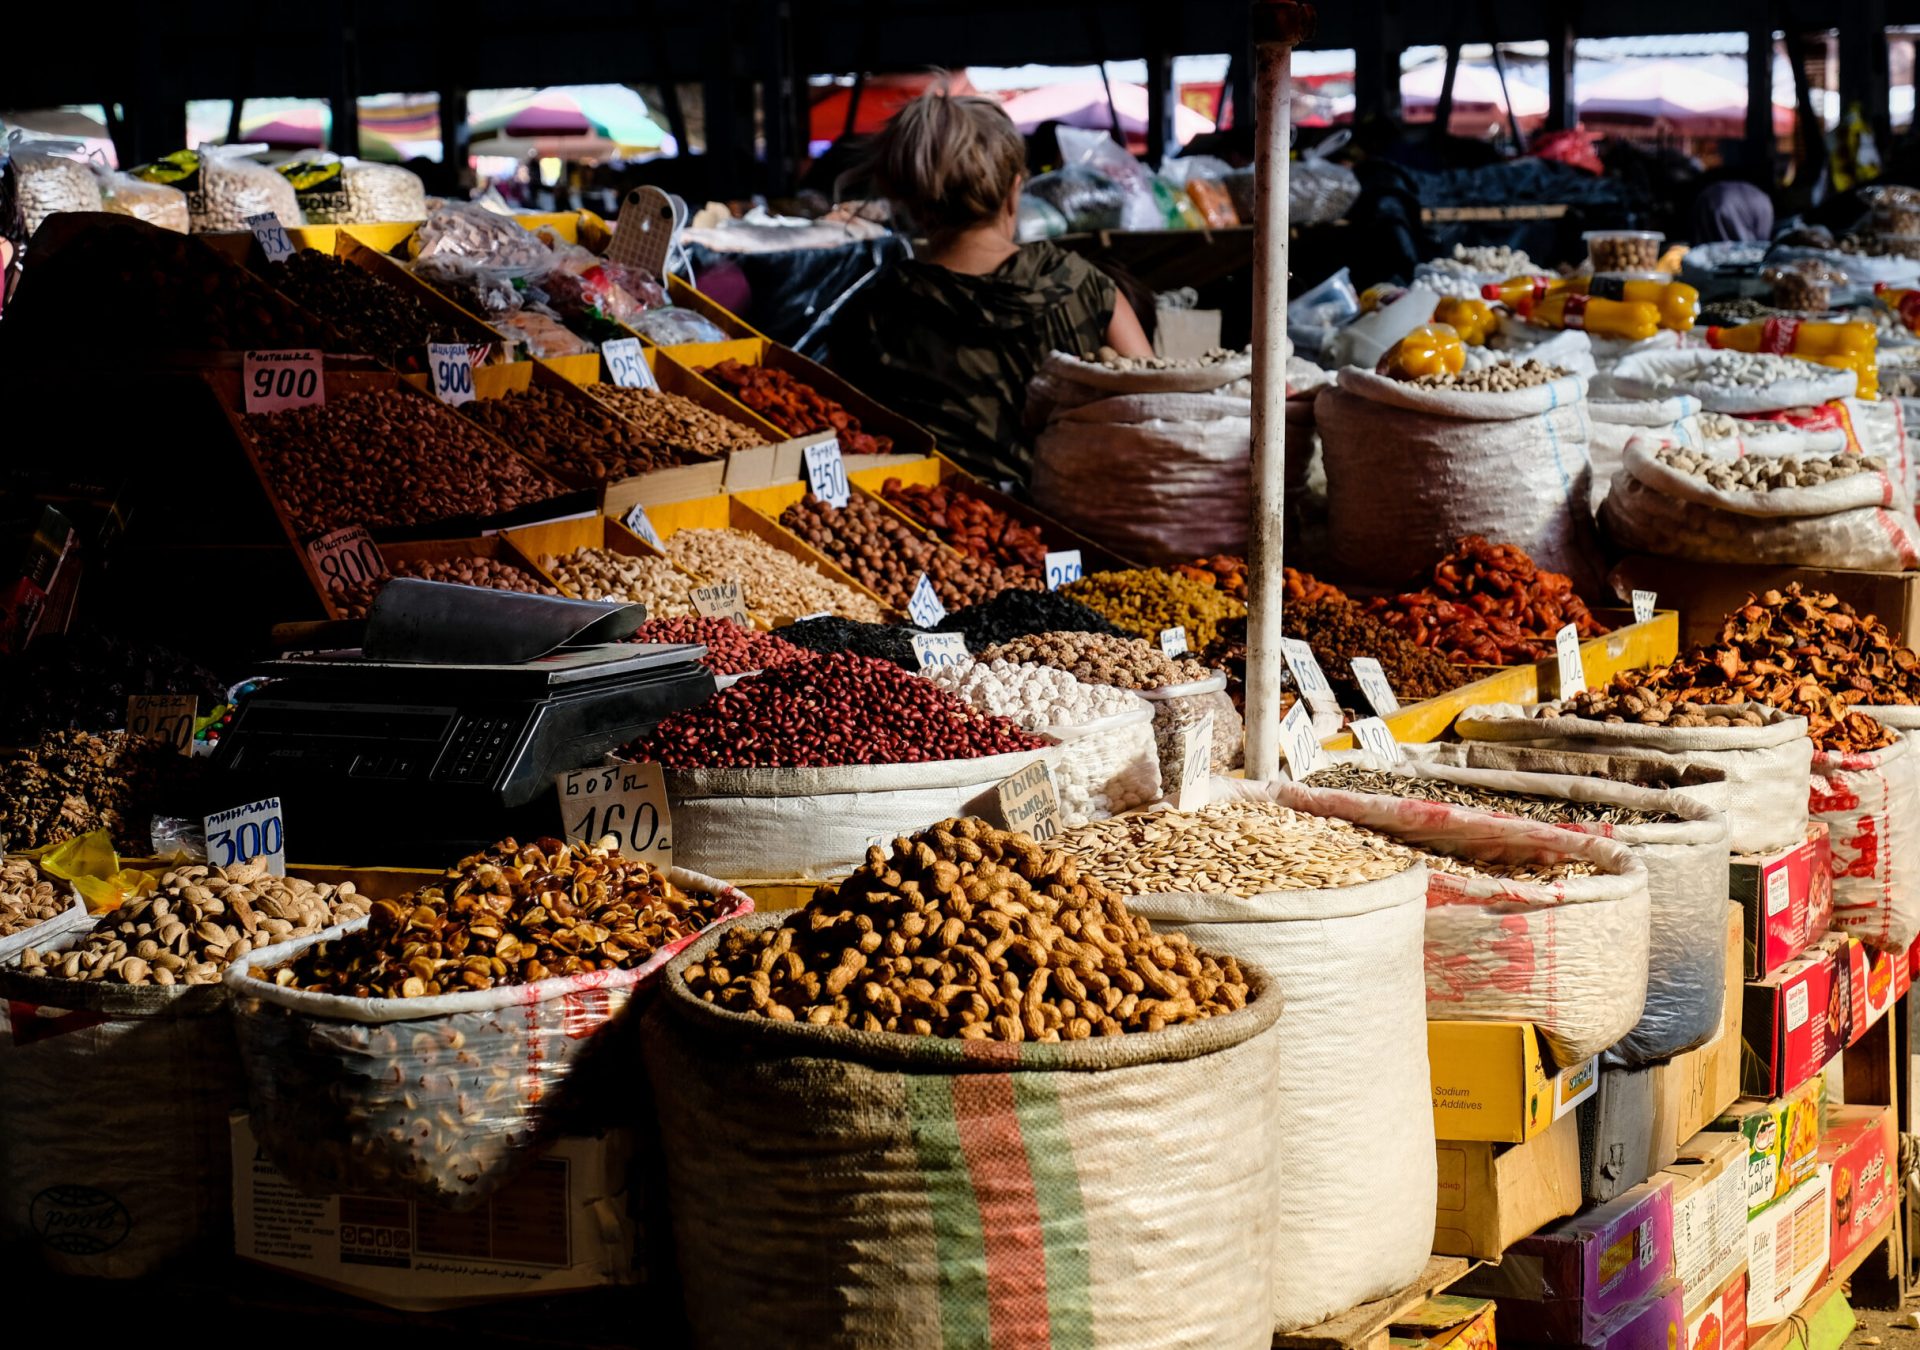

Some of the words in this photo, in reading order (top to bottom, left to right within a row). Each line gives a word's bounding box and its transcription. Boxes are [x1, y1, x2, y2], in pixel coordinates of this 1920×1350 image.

[253, 367, 318, 398] 900
[439, 360, 471, 394] 900
[813, 458, 845, 501] 750
[320, 538, 385, 594] 800
[207, 816, 283, 868] 300
[1435, 1086, 1470, 1098] Sodium
[1440, 1099, 1483, 1110] Additives
[45, 1207, 115, 1239] good
